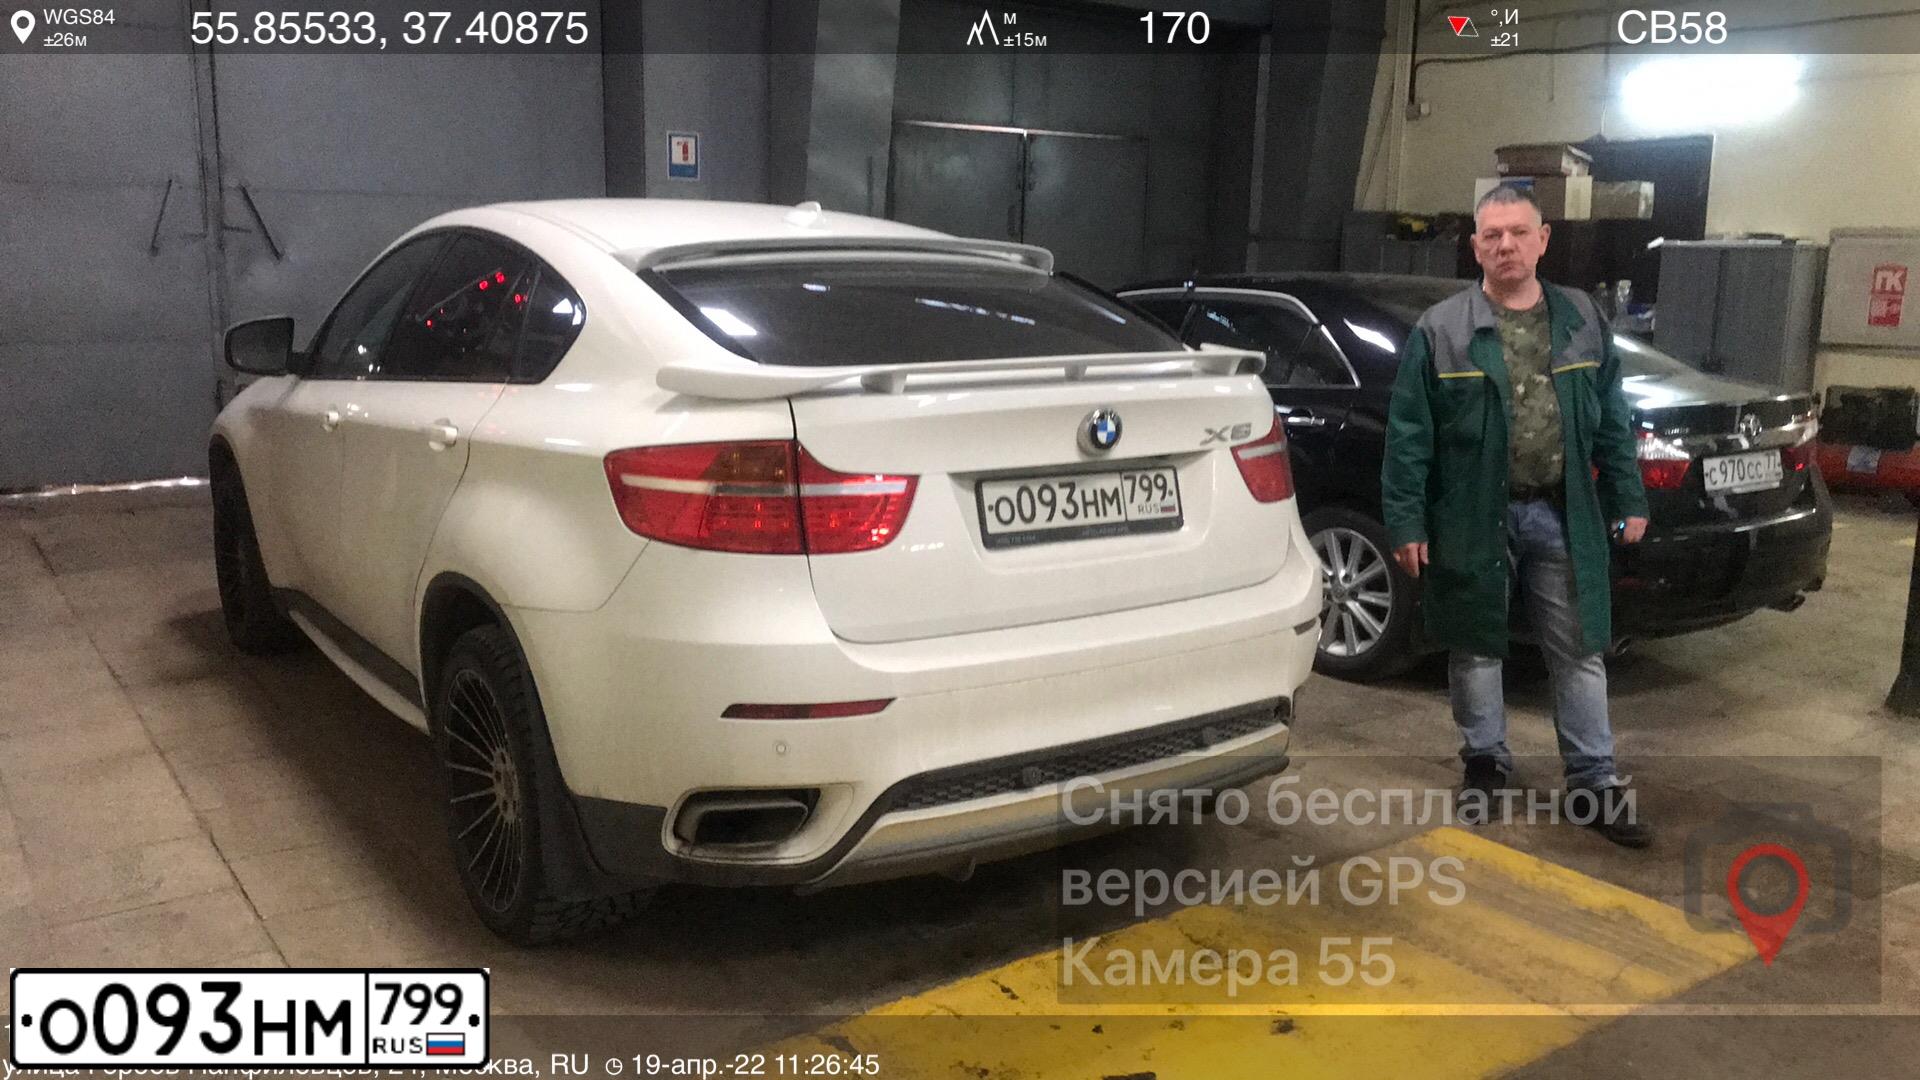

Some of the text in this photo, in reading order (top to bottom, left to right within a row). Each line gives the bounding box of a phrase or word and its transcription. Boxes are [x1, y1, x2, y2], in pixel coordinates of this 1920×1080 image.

[1199, 422, 1252, 446] X6
[994, 473, 1168, 526] О093НМ 799
[1137, 502, 1161, 514] RUS
